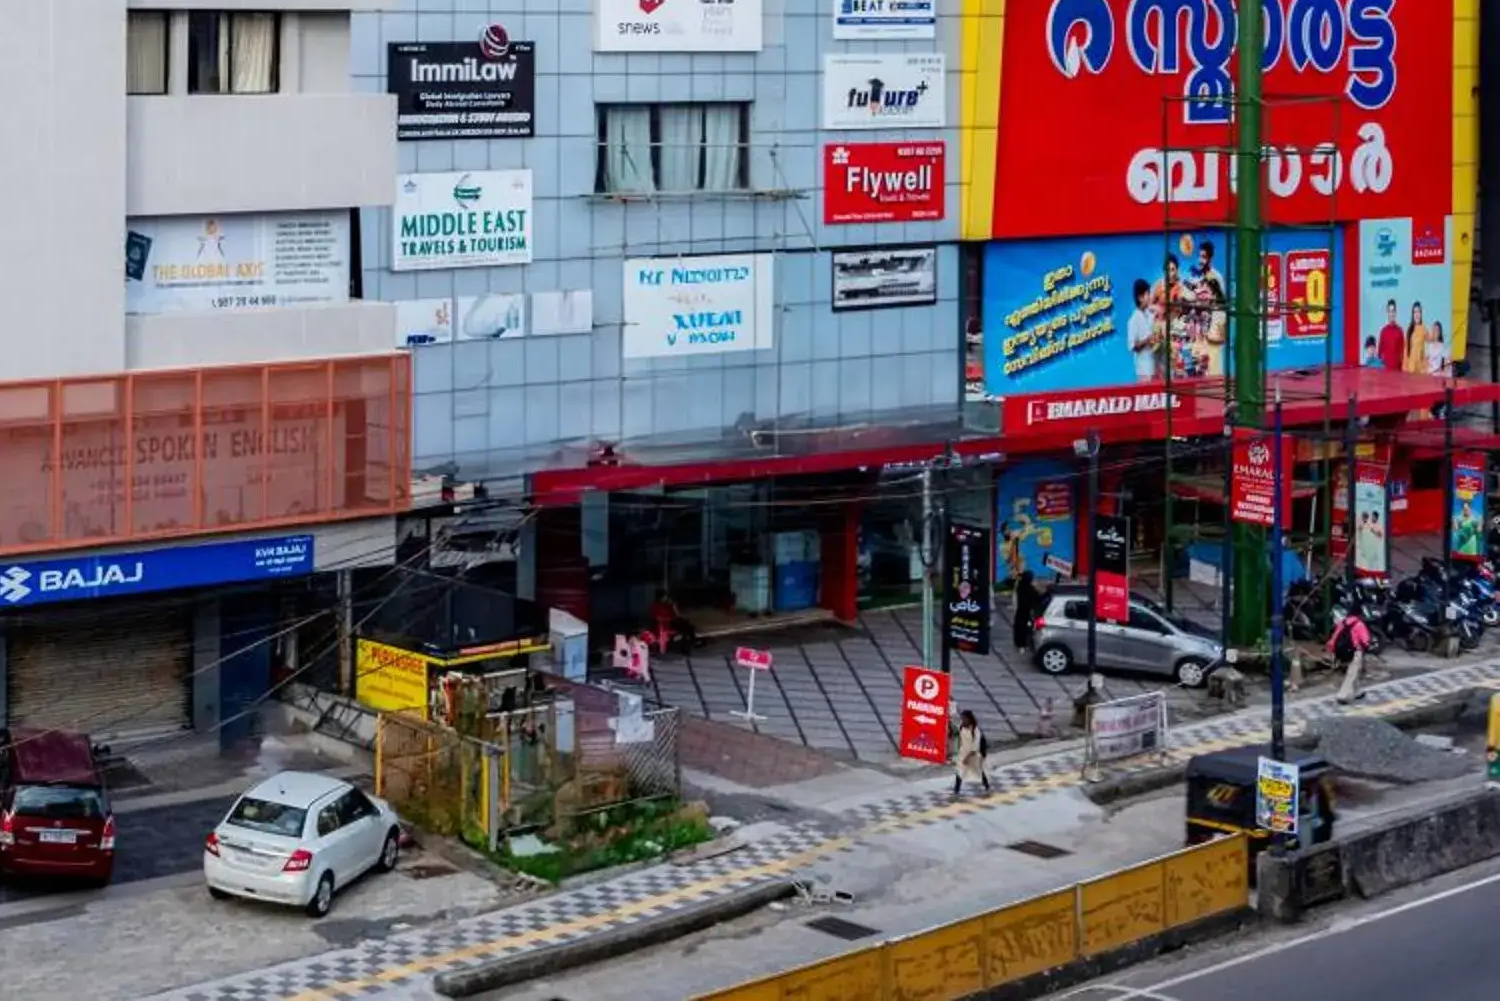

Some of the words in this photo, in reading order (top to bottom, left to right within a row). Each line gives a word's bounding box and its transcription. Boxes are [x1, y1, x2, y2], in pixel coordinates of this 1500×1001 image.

[411, 57, 518, 83] ImmiLaw
[847, 164, 933, 197] Flywell
[401, 212, 477, 238] MIDDLE
[484, 209, 527, 234] EAST
[402, 240, 454, 256] TRAVELS
[459, 238, 467, 253] &
[471, 236, 527, 252] TOURISM
[1047, 397, 1131, 420] EMARALD
[39, 562, 144, 592] BAJAJ
